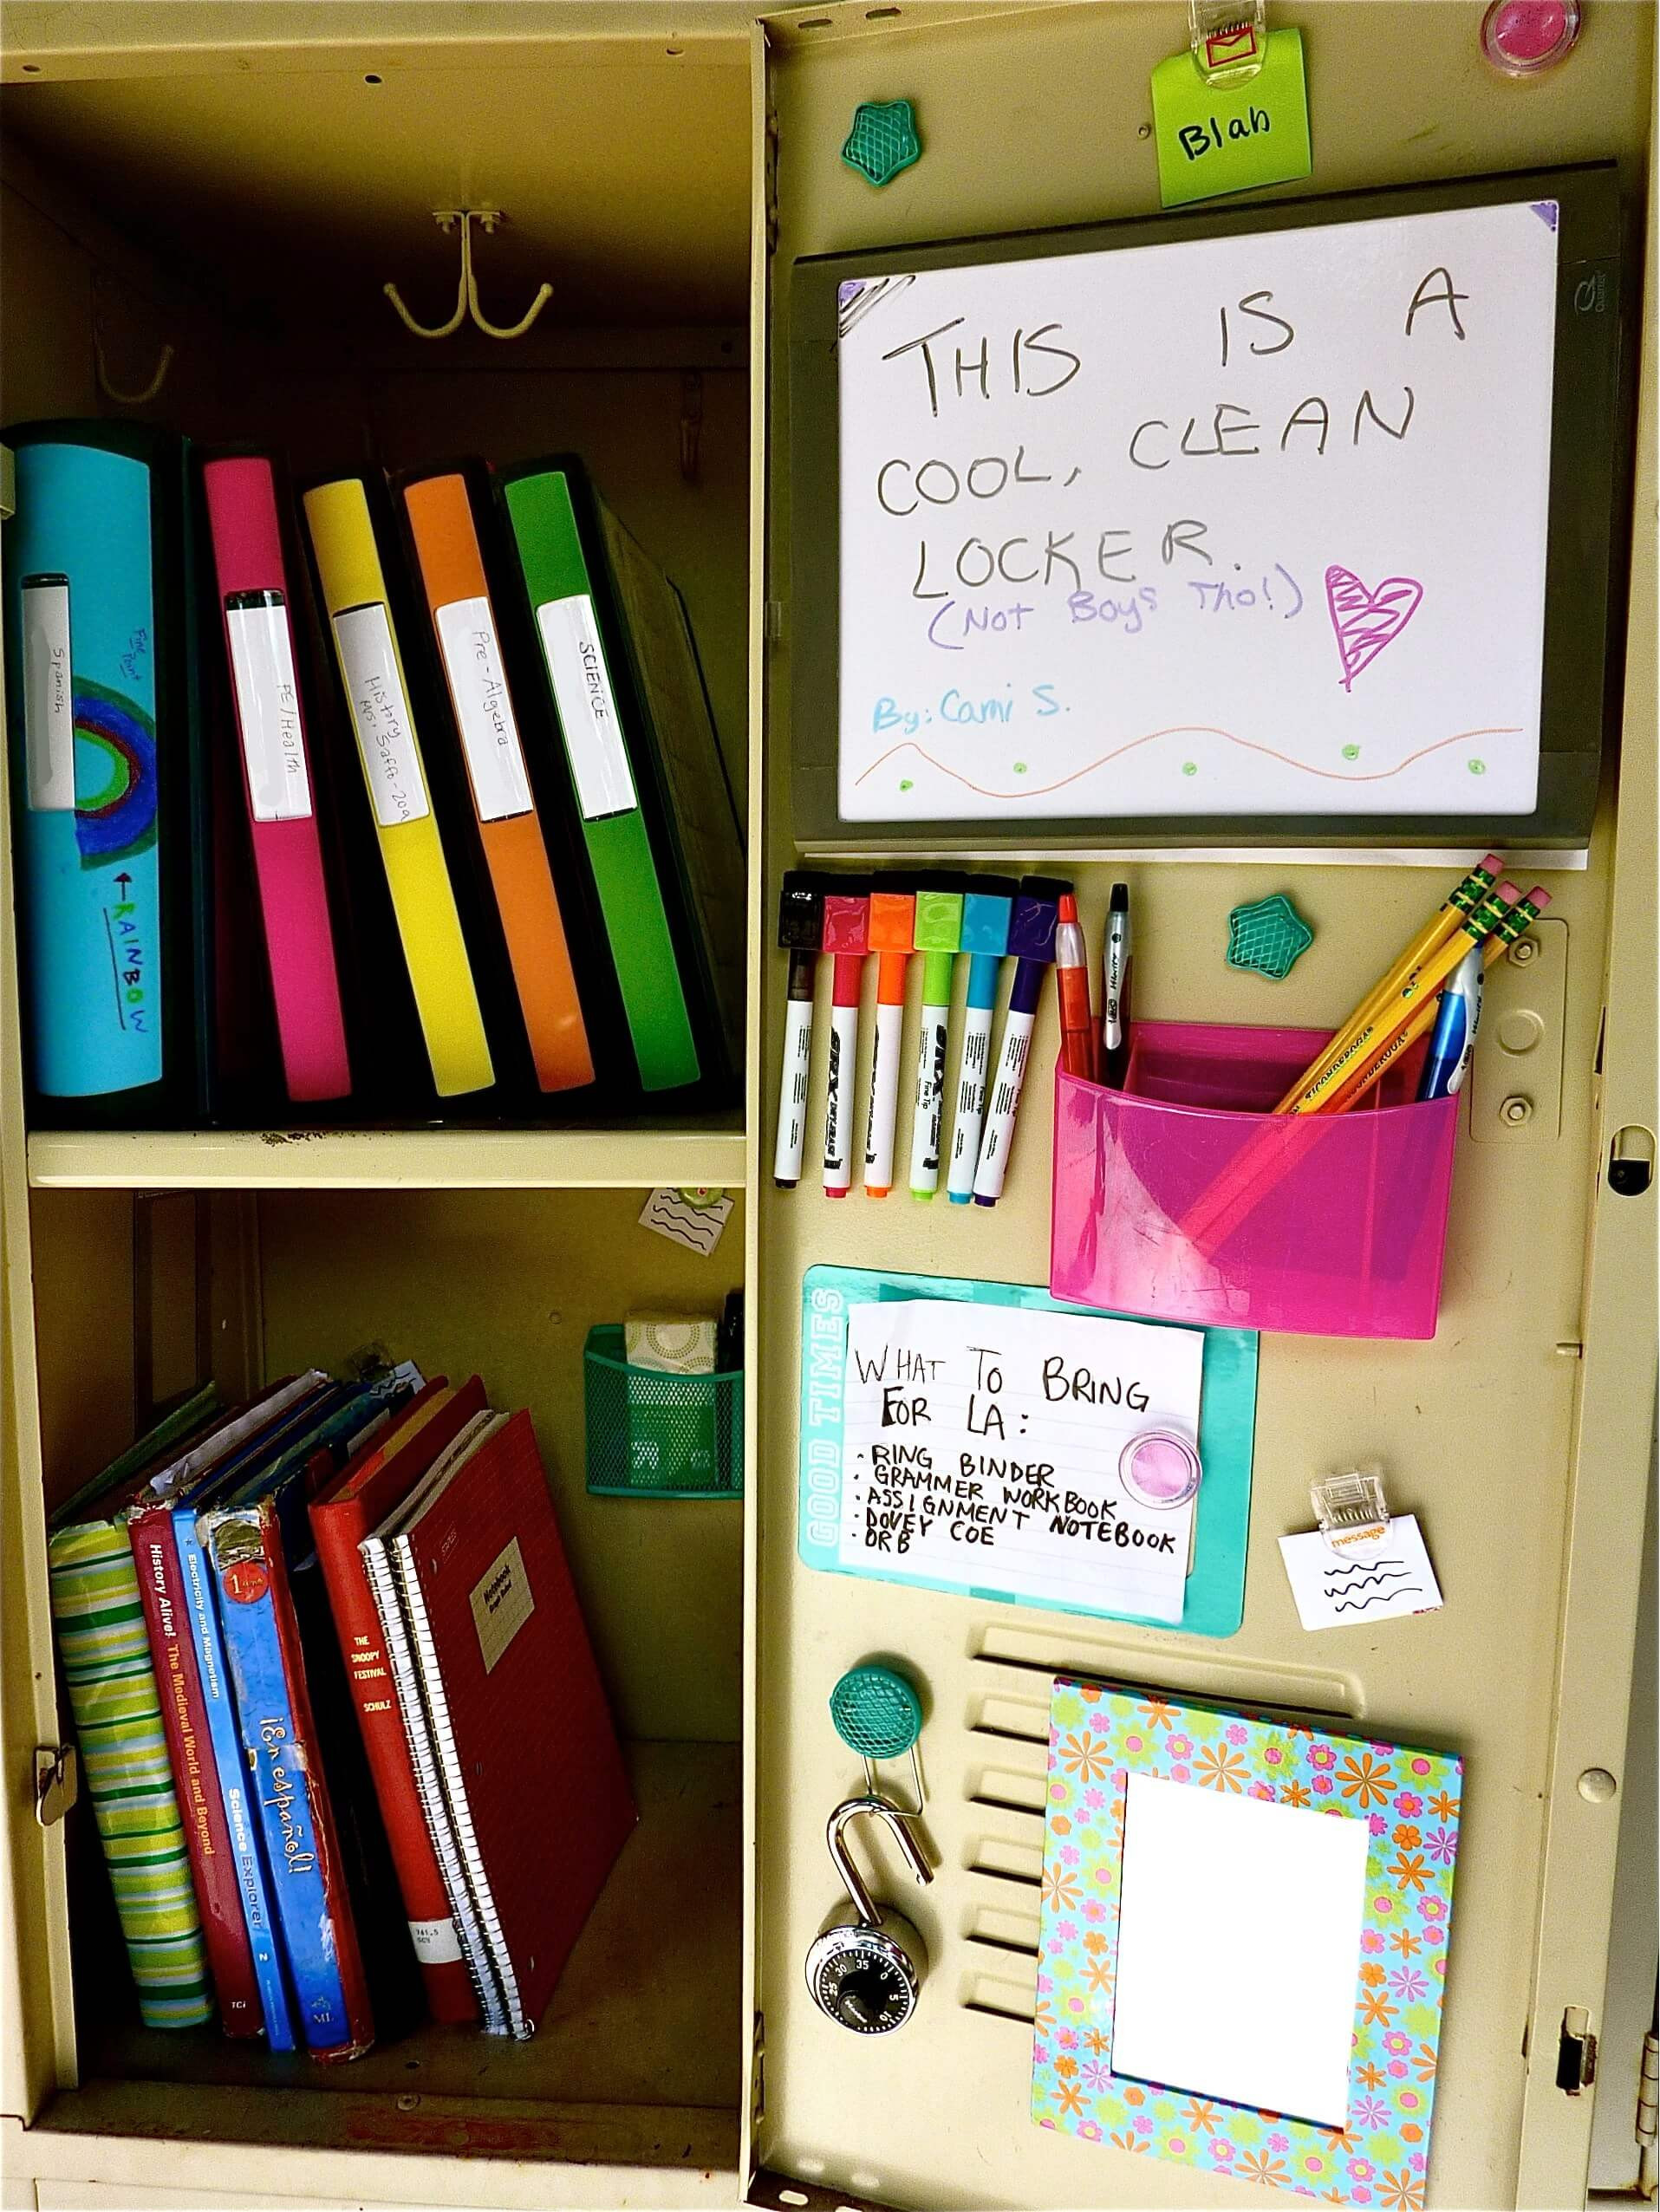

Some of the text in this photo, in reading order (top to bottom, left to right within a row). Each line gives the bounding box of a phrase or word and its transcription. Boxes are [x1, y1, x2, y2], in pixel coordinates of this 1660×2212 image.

[882, 267, 1468, 418] THIS IS A
[877, 387, 1414, 516] COOL, CLEAN
[912, 518, 1240, 599] LOCKER.
[1067, 586, 1158, 634] Boys
[1187, 563, 1303, 620] Tho!)
[51, 647, 66, 713] Spanish
[365, 676, 401, 738] History
[578, 641, 609, 719] SCIENCE
[873, 682, 1071, 735] By: Cami S.
[113, 902, 149, 1033] RAINBOW
[855, 1343, 946, 1385] WHAT
[1042, 1356, 1150, 1413] BRING
[881, 1386, 932, 1428] FOR
[807, 1287, 845, 1548] GOOD TIMES
[871, 1444, 1055, 1488] RING BINDER
[874, 1464, 1118, 1520] GRAMMER WORKBOOK
[866, 1506, 995, 1545] DOVEY COE
[868, 1487, 1177, 1553] ASSIGNMENT NOTEBOOK
[1331, 1525, 1386, 1547] message
[187, 1552, 220, 1699] Electricity and Magnetism
[350, 1649, 380, 1663] SNOOPY
[354, 1636, 370, 1646] THE
[149, 1544, 216, 1856] History Alive! The Medieval World and Beyond
[353, 1667, 387, 1680] FESTIVAL
[362, 1699, 392, 1713] SCHULZ
[263, 1766, 316, 1874] español!
[229, 1788, 262, 1927] Science Explorer
[835, 1963, 848, 1977] 30
[856, 1960, 869, 1970] 35
[880, 1971, 889, 1981] 0
[879, 2010, 892, 2022] 10
